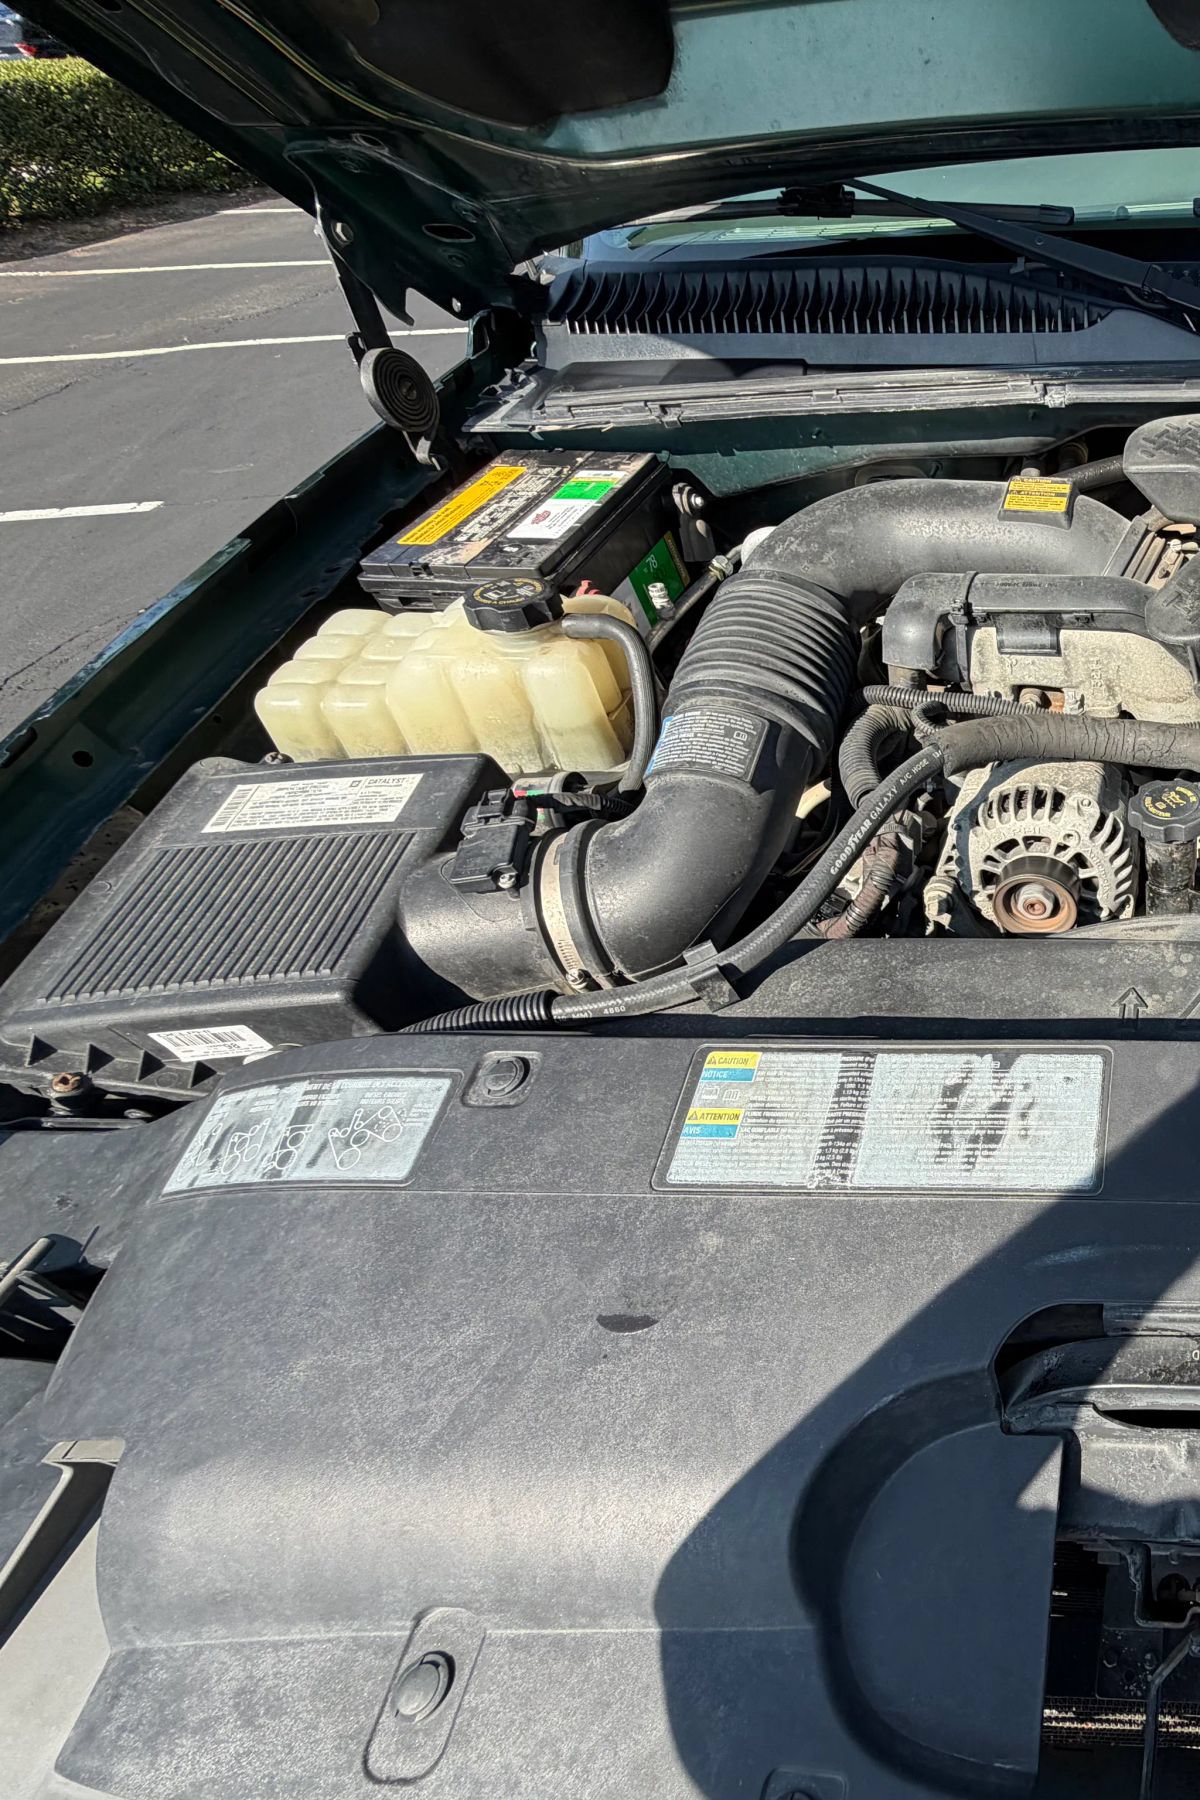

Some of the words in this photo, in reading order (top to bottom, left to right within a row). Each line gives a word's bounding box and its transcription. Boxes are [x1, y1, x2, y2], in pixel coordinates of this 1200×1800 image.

[829, 818, 873, 876] GOODYEAR
[869, 784, 899, 821] GALAXY
[899, 772, 912, 786] A/C
[912, 758, 929, 774] HOSE
[717, 1056, 749, 1066] CAUTION
[702, 1070, 728, 1079] NOTICE
[698, 1111, 741, 1122] ATTENTION
[683, 1125, 702, 1135] AVIS
